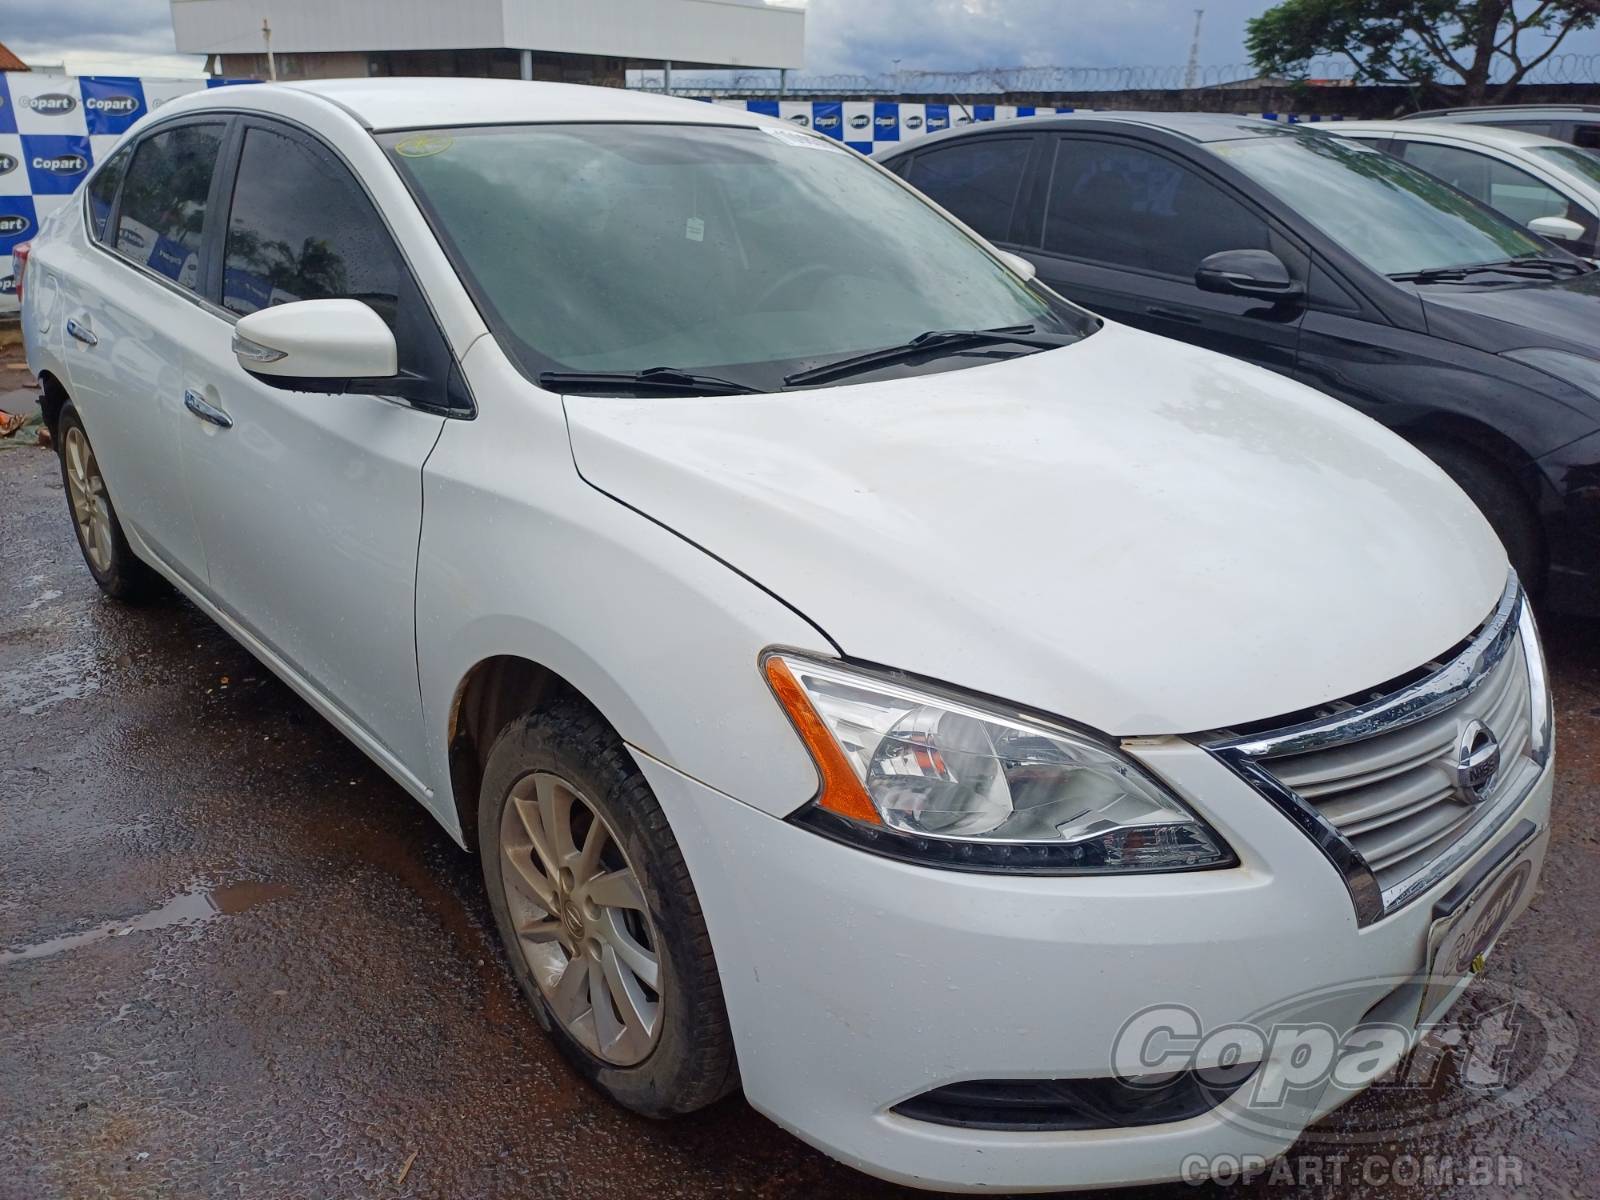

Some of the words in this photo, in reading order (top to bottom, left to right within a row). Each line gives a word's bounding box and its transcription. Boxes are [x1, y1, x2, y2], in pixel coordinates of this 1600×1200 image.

[20, 96, 69, 110] Copart
[86, 97, 133, 112] Copart
[32, 157, 82, 169] Copart
[0, 219, 22, 230] art
